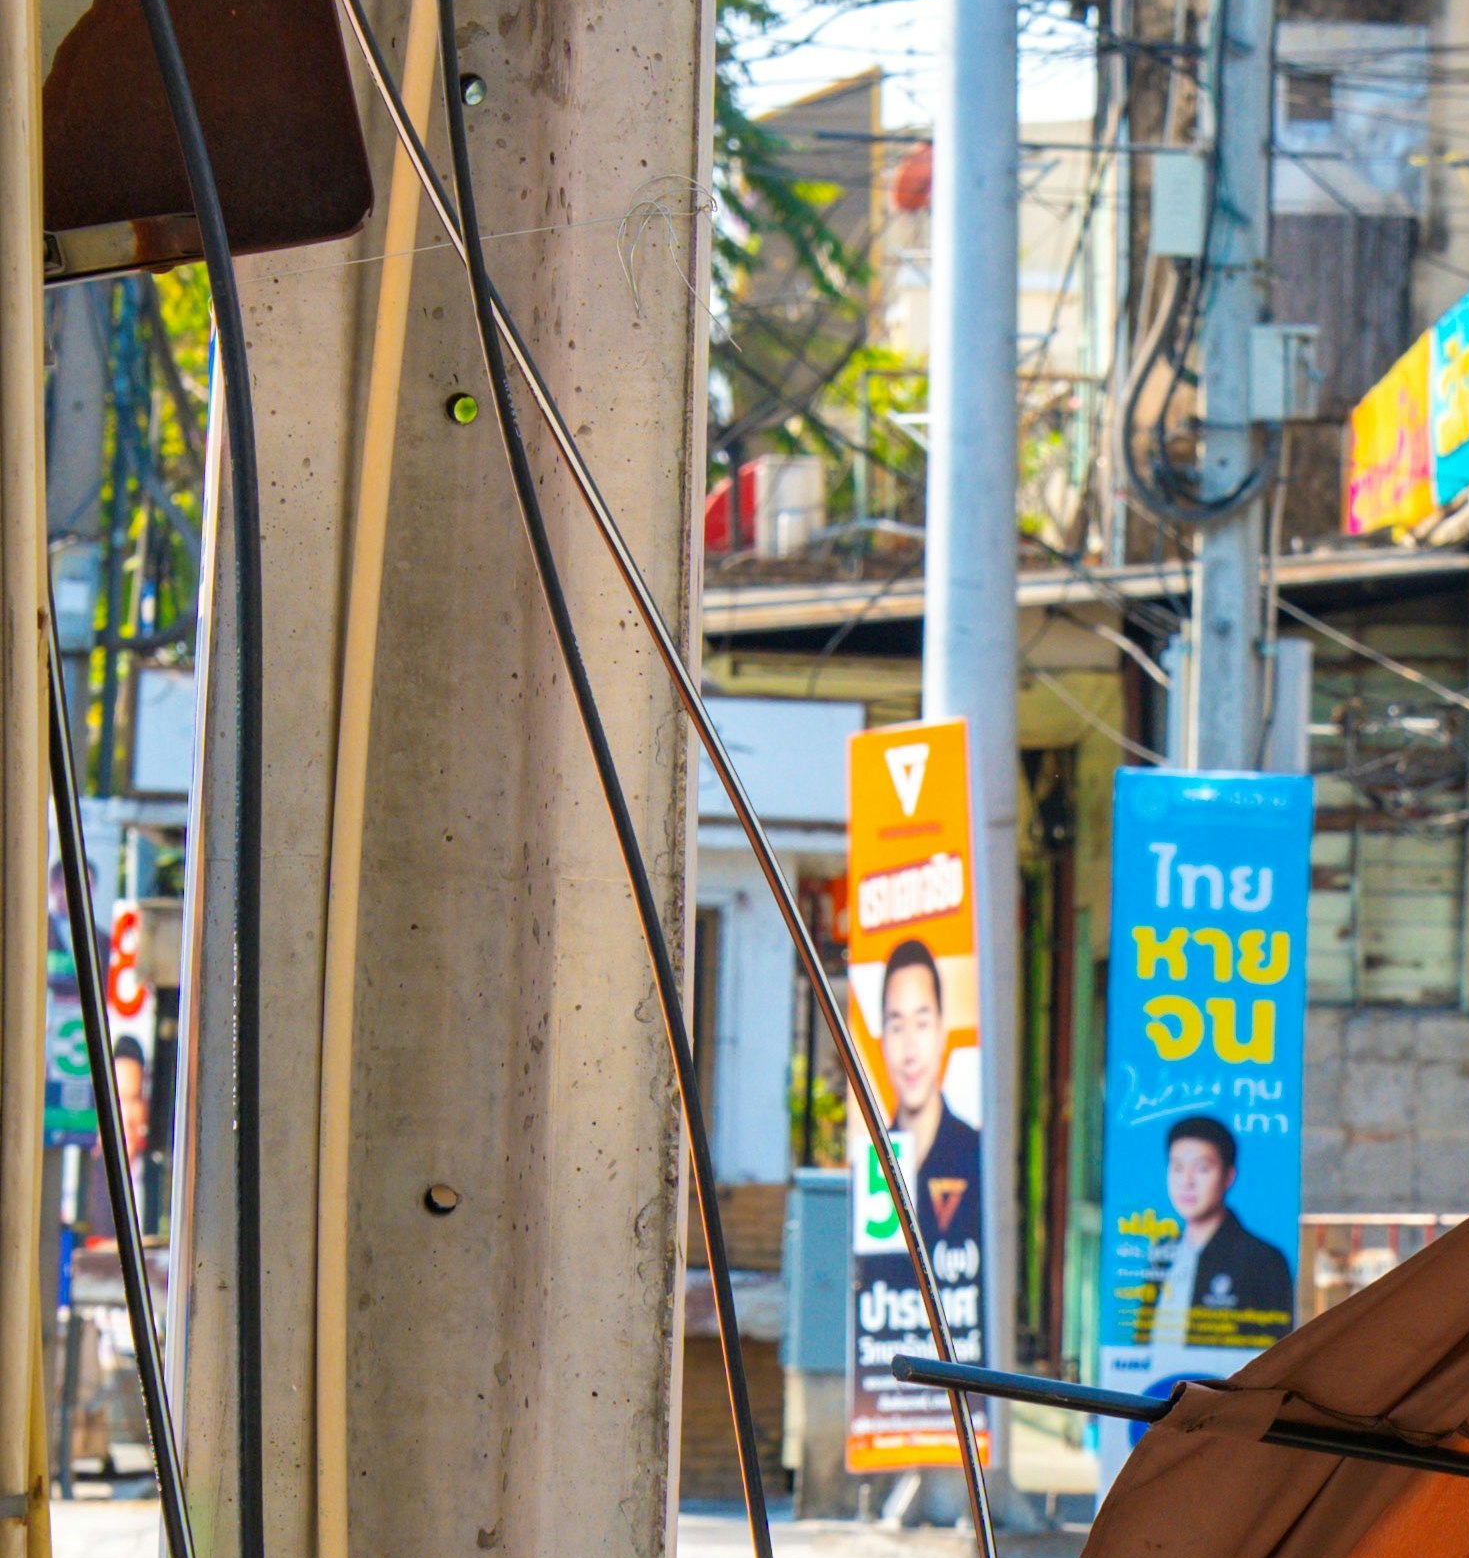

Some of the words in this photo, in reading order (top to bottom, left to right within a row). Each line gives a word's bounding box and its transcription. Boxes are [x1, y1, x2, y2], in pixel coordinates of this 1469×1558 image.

[1148, 841, 1274, 913] ไทย
[1131, 925, 1291, 986] หาย
[1142, 994, 1277, 1065] จน
